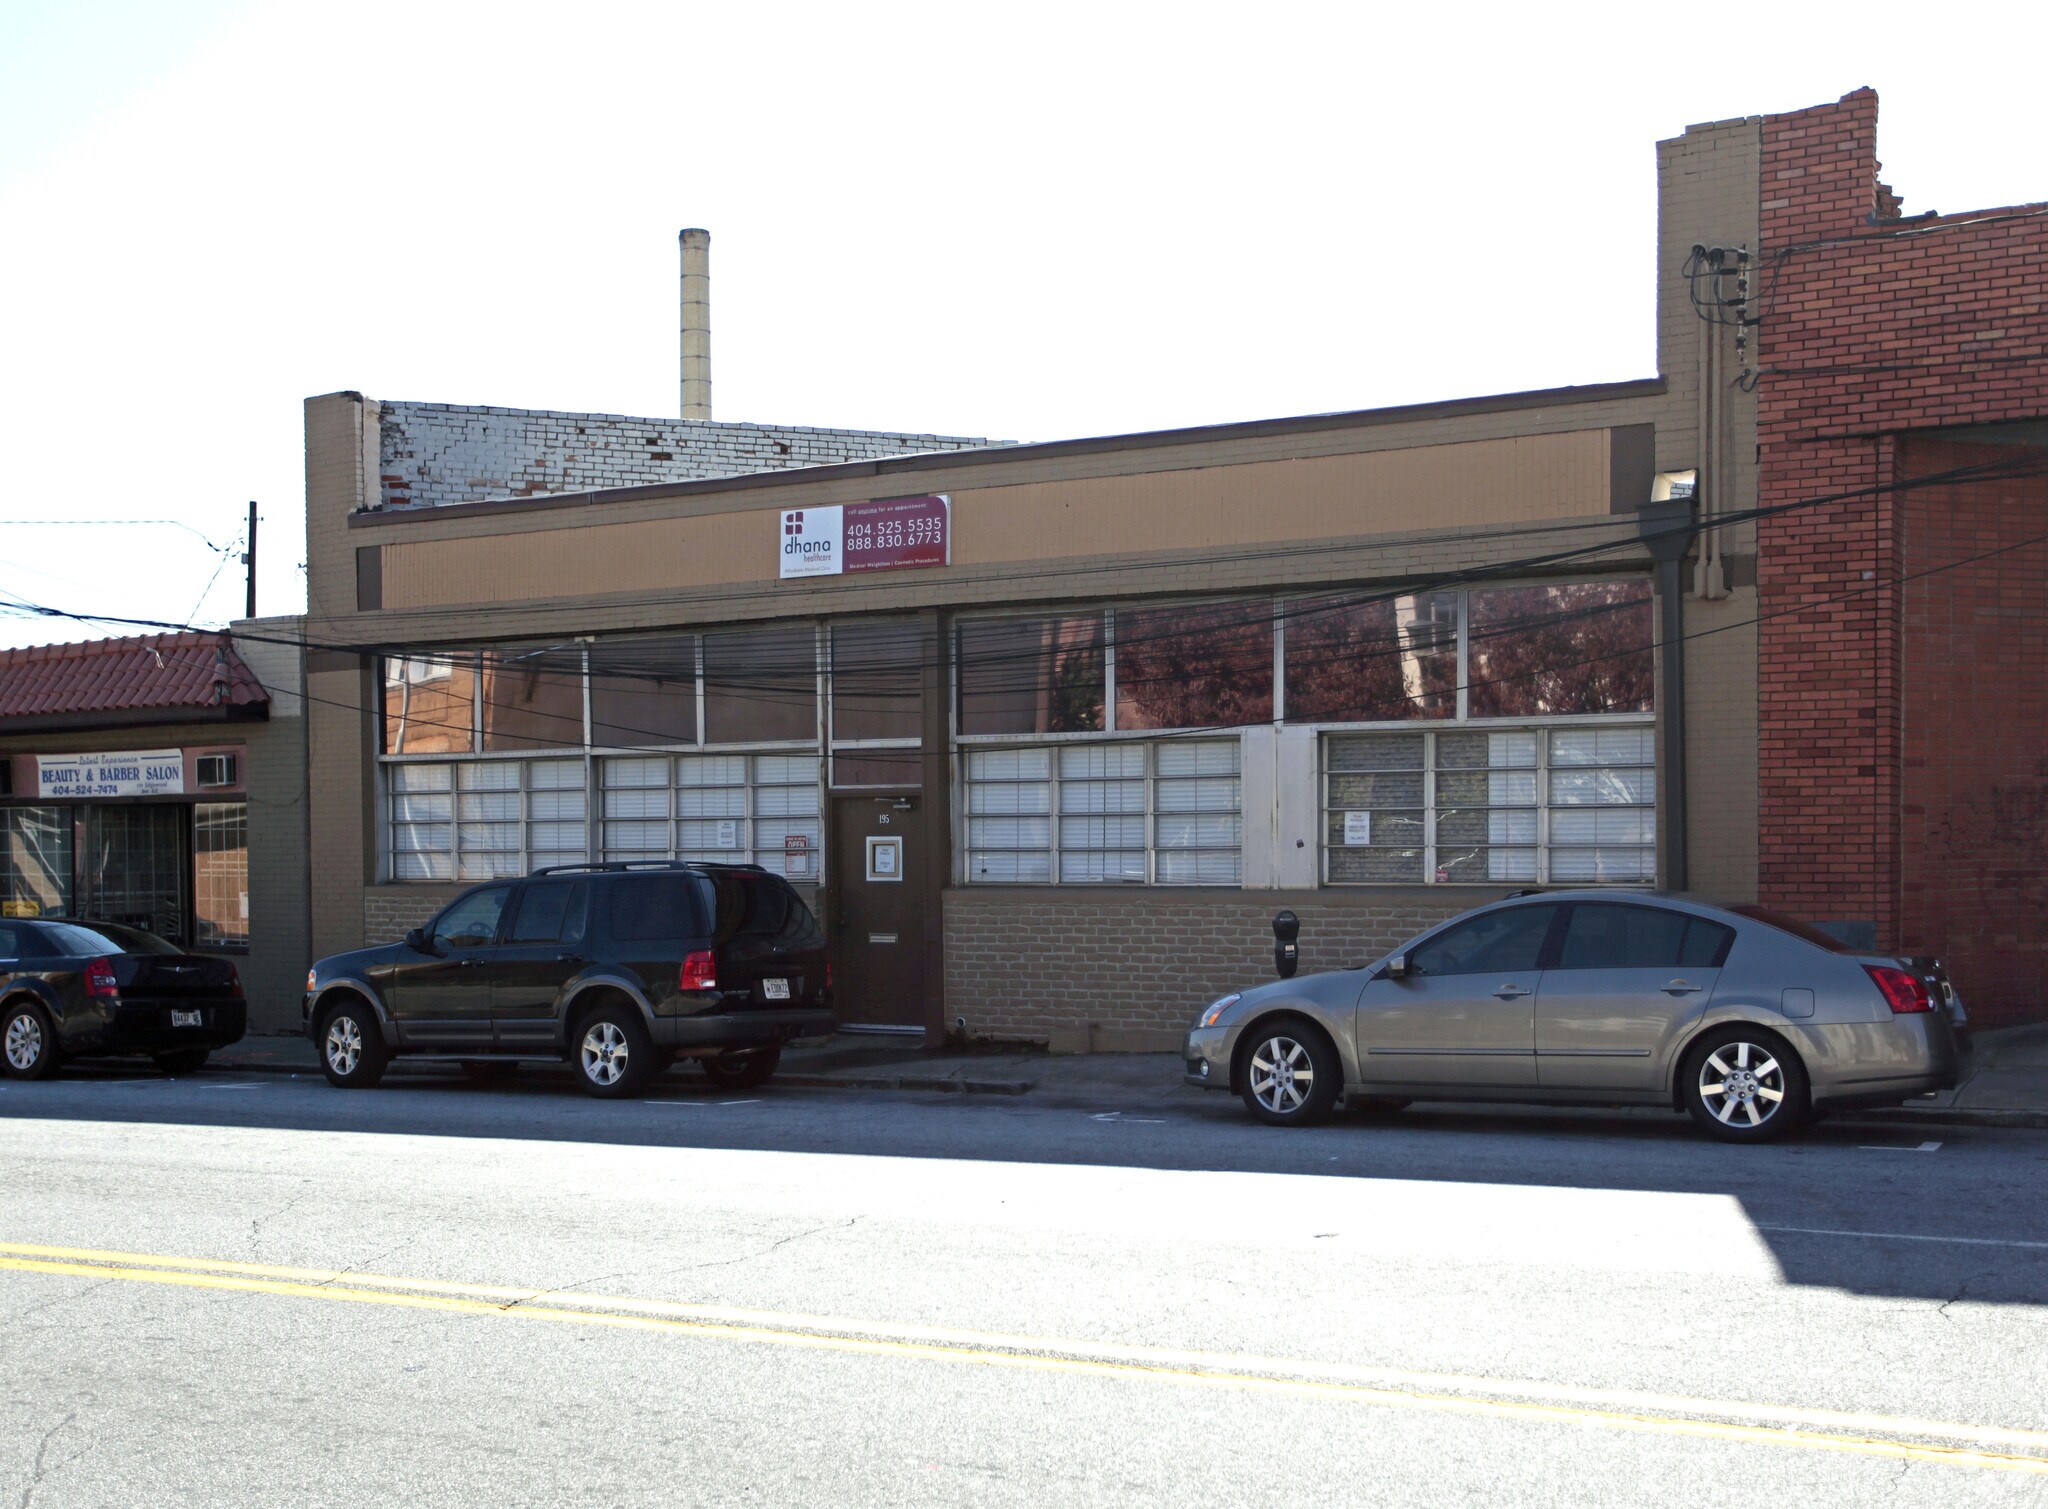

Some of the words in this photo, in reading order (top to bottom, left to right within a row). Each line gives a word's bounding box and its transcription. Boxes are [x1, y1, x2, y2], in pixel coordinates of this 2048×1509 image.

[847, 518, 942, 537] 404.525.5535
[784, 537, 831, 554] dhana
[847, 532, 942, 551] 888.830.6773
[803, 551, 832, 563] healthcare
[42, 769, 81, 784] BEAUTY
[86, 768, 94, 782] &
[100, 766, 140, 782] BARBER
[146, 766, 180, 780] SALON
[52, 784, 119, 795] 404-524-7474
[879, 814, 890, 824] 195
[787, 840, 805, 848] OPEN
